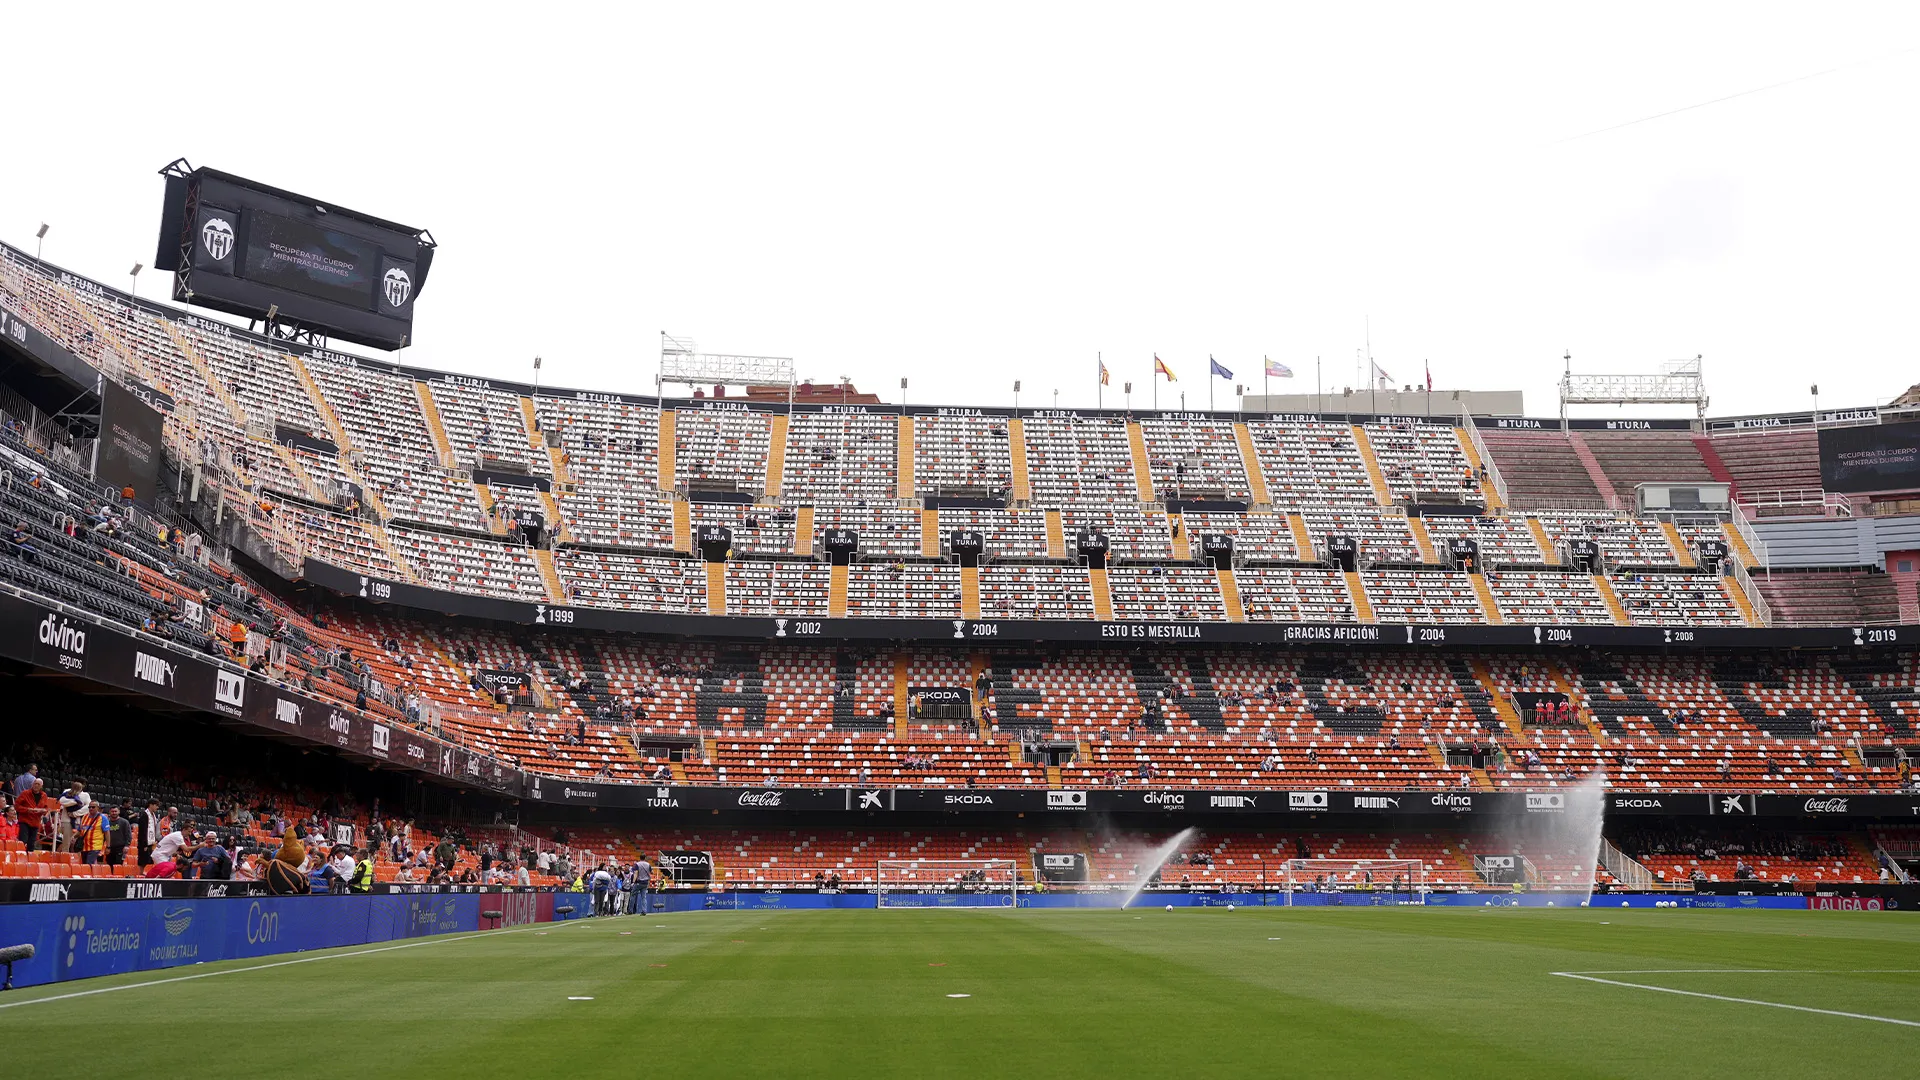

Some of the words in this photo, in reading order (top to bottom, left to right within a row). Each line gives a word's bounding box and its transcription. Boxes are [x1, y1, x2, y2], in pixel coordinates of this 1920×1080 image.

[270, 242, 311, 260] RECUPERA
[312, 254, 322, 262] TU
[323, 257, 354, 271] CUERPO
[273, 252, 312, 268] MIENTRAS
[313, 262, 349, 278] DUERMES
[73, 276, 104, 296] TURIA
[10, 319, 26, 342] 1980
[200, 318, 232, 336] TURIA
[324, 351, 358, 366] TURIA
[456, 376, 490, 389] TURIA
[588, 393, 622, 404] TURIA
[716, 402, 749, 412] TURIA
[834, 406, 868, 414] TURIA
[950, 408, 982, 418] TURIA
[1174, 412, 1206, 421] TURIA
[1284, 414, 1317, 423] TURIA
[1390, 416, 1424, 425] TURIA
[1840, 410, 1875, 420] TURIA
[1508, 419, 1541, 428] TURIA
[1617, 421, 1650, 430] TURIA
[1748, 418, 1782, 428] TURIA
[1838, 450, 1876, 460] RECUPERA
[1887, 448, 1918, 456] CUERPO
[1842, 458, 1878, 466] MIENTRAS
[1879, 456, 1914, 464] DUERMES
[516, 518, 538, 527] TURIA
[704, 533, 726, 542] TURIA
[830, 537, 853, 545] TURIA
[1081, 540, 1104, 548] TURIA
[1572, 547, 1594, 555] TURIA
[371, 582, 391, 599] 1999
[549, 610, 574, 624] 1999
[40, 613, 85, 654] divina
[795, 622, 821, 634] 2002
[972, 624, 998, 636] 2004
[1102, 625, 1128, 638] ESTO
[1132, 625, 1145, 638] ES
[1148, 625, 1200, 638] MESTALLA
[1284, 627, 1331, 641] ¡GRACIAS
[1334, 626, 1379, 640] AFICIÓN!
[1420, 629, 1445, 641] 2004
[1548, 629, 1572, 641] 2004
[1675, 631, 1694, 642] 2008
[1868, 629, 1897, 642] 2019
[58, 653, 82, 670] seguros
[134, 651, 166, 686] PUMA
[219, 678, 228, 696] TM
[330, 710, 350, 735] divina
[646, 798, 678, 808] TURIA
[738, 790, 784, 806] Coca-Cola
[1144, 792, 1184, 804] divina
[1210, 796, 1245, 808] PUMA
[1354, 797, 1389, 808] PUMA
[1431, 794, 1471, 806] divina
[1804, 798, 1850, 813] Coca-Cola
[136, 884, 162, 898] TURIA
[1002, 895, 1030, 907] Con
[1810, 898, 1862, 911] LALIGA
[501, 892, 528, 929] LALIGA
[247, 901, 278, 944] Con
[86, 928, 140, 954] Telefónica
